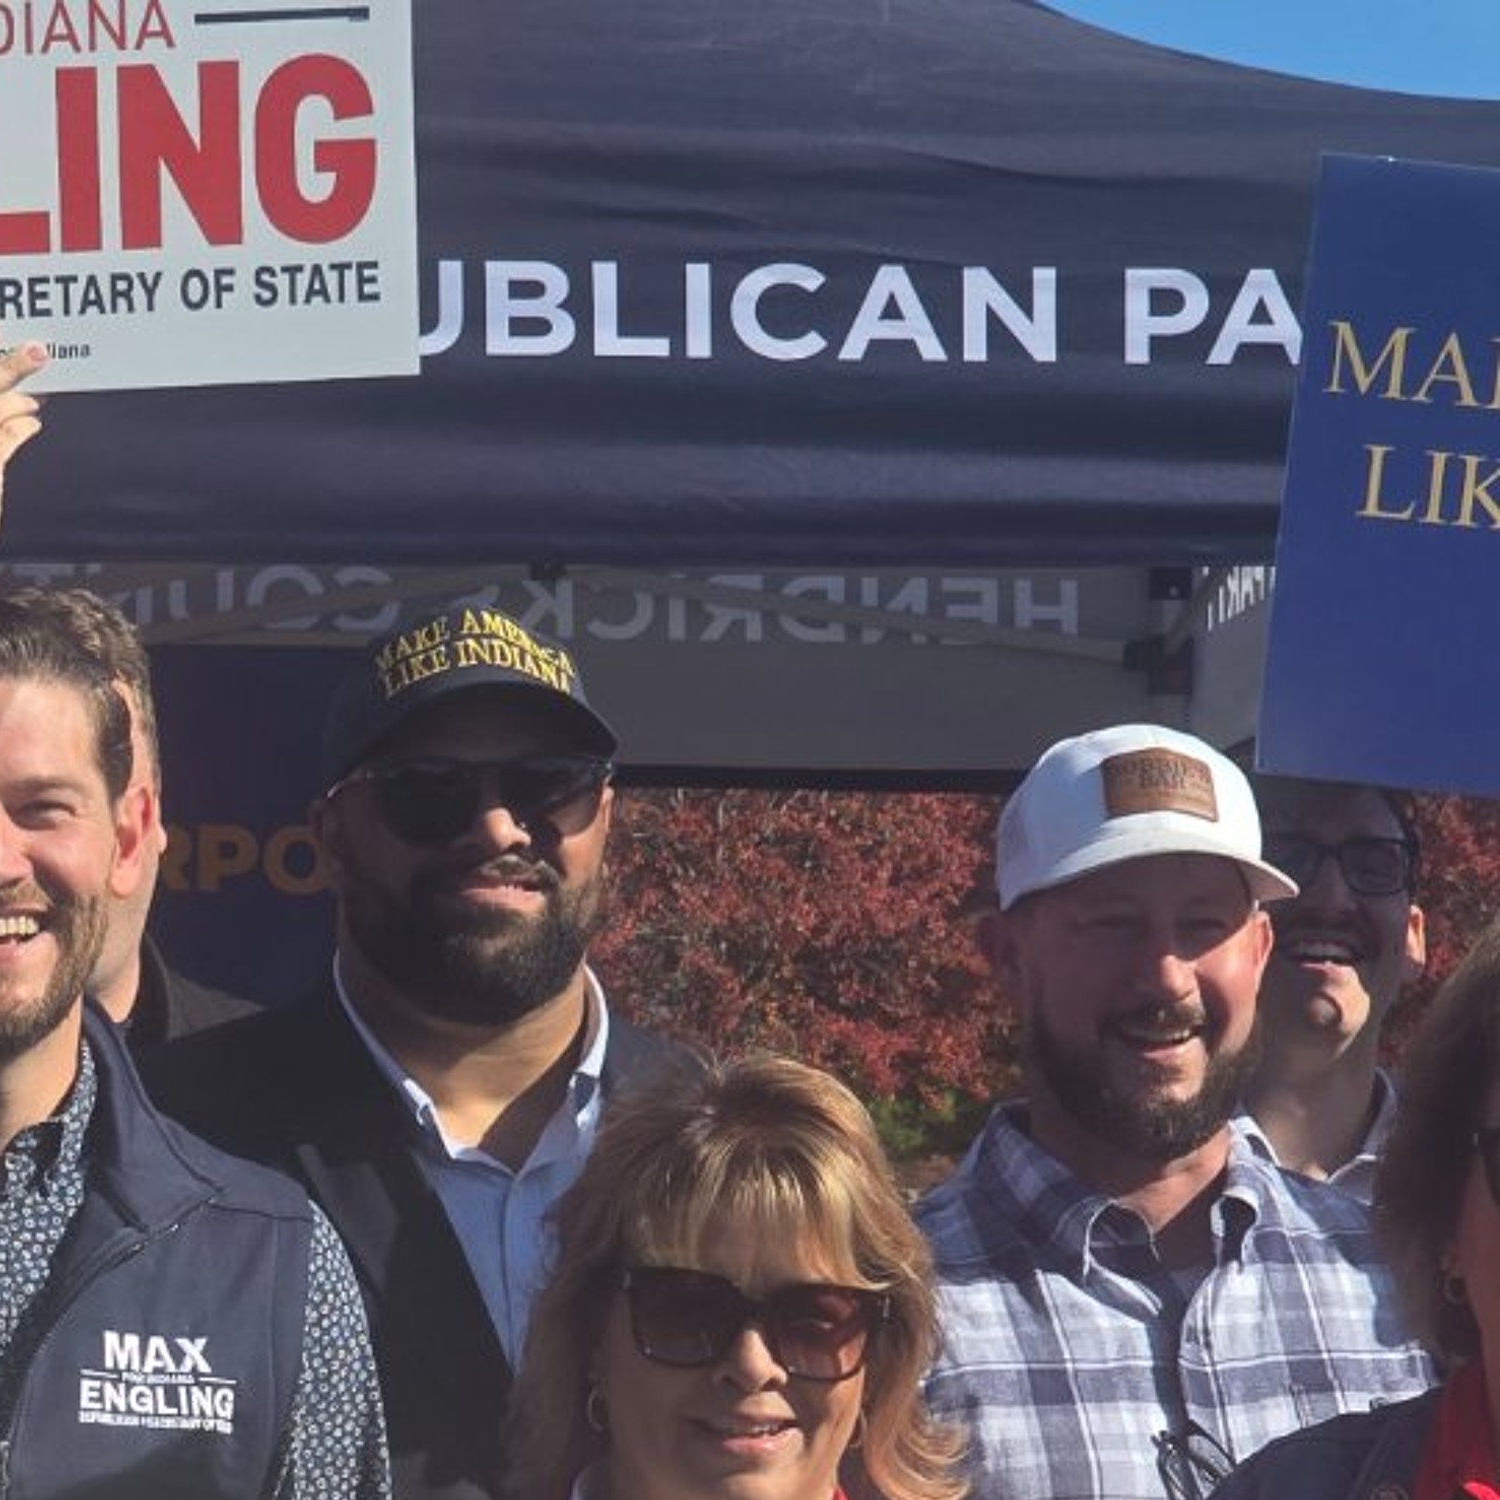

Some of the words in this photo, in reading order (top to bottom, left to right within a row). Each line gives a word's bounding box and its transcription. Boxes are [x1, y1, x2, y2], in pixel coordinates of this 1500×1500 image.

[180, 267, 237, 312] OF
[252, 260, 382, 308] STATE
[103, 1329, 213, 1374] MAX
[79, 1379, 235, 1420] ENGLING
